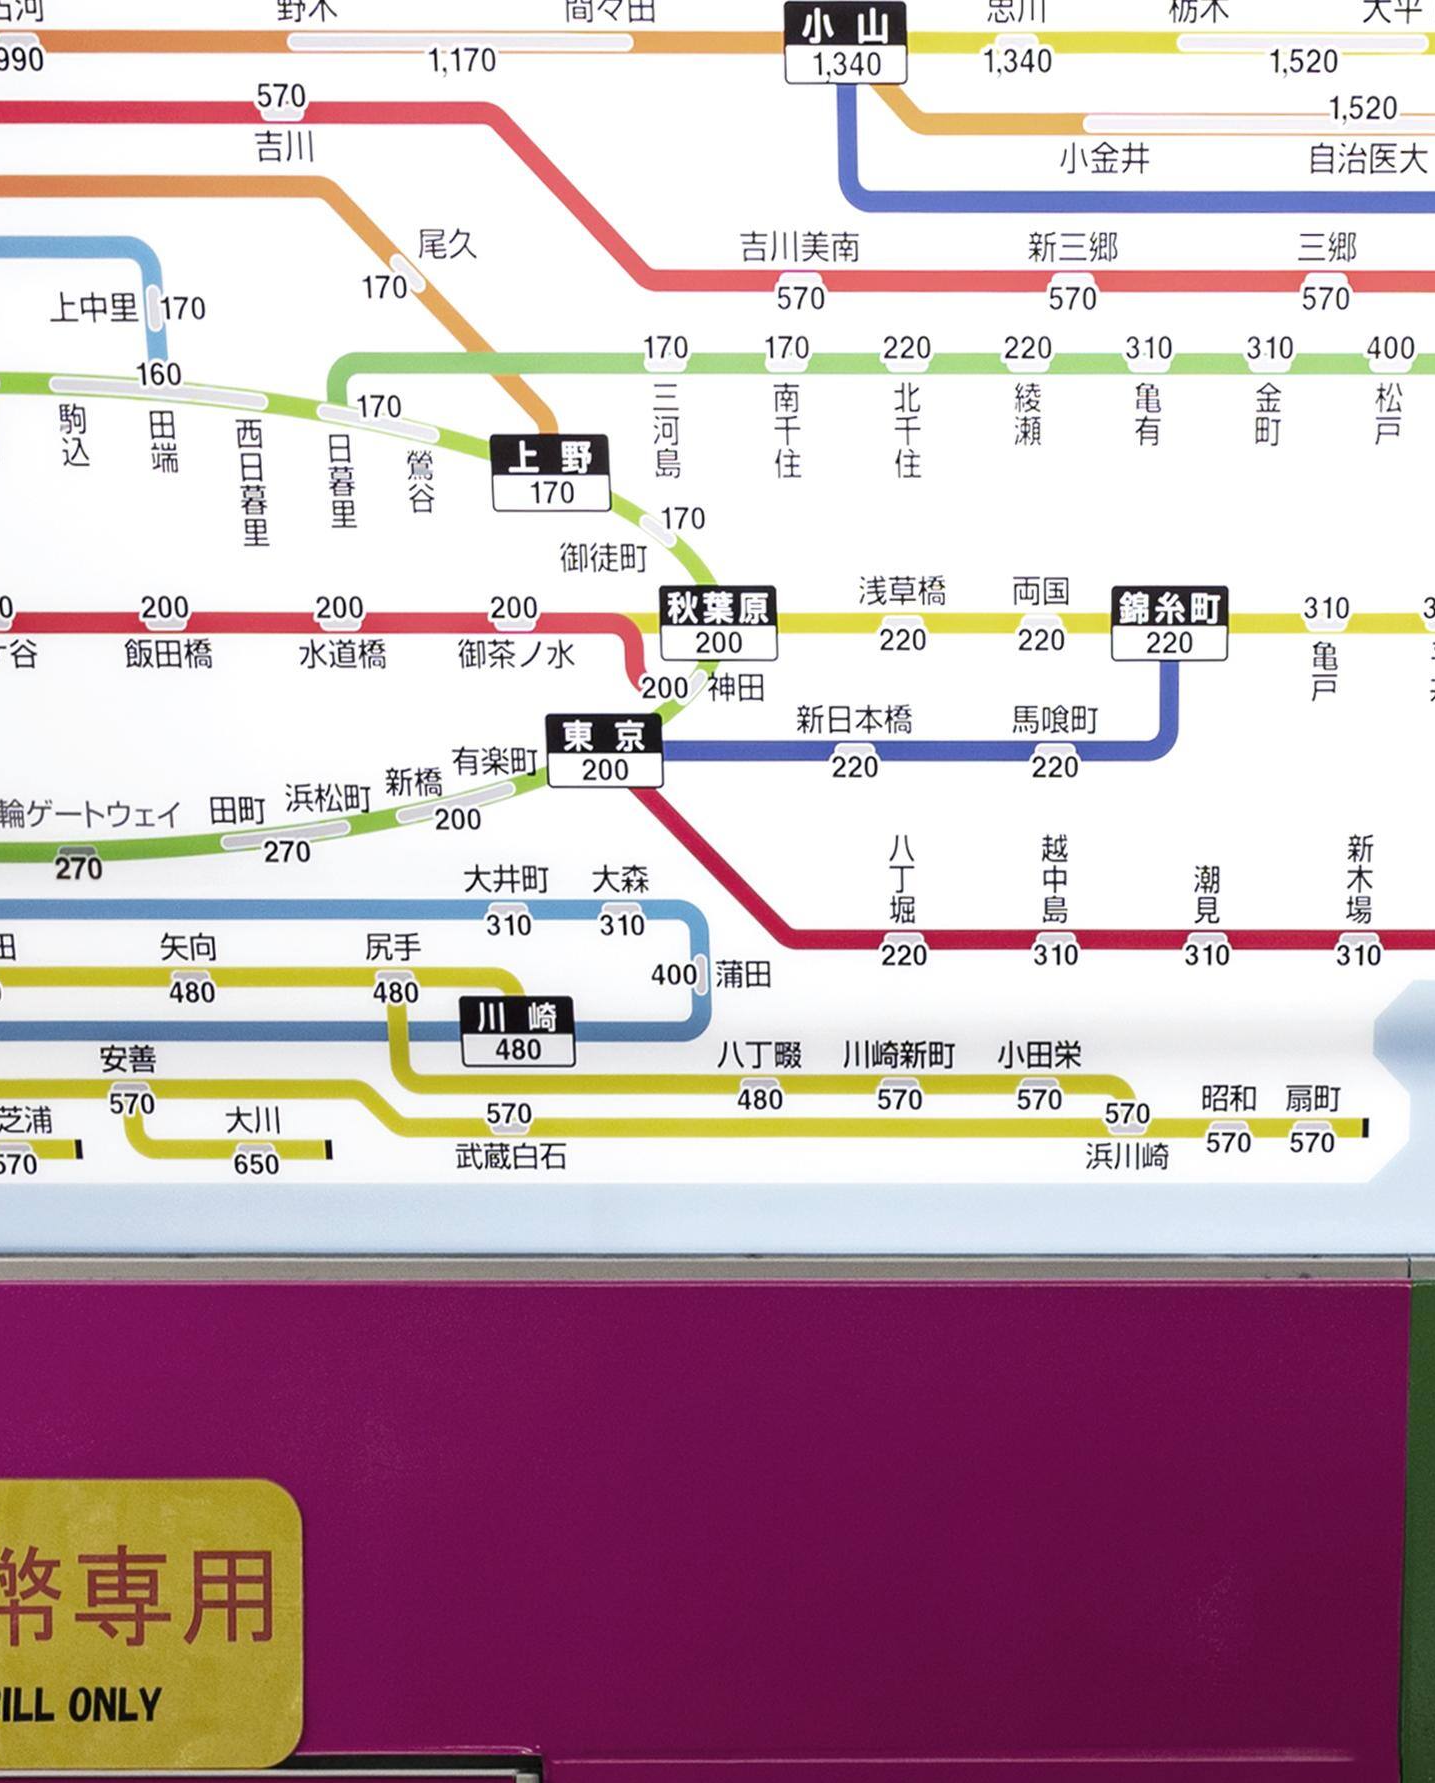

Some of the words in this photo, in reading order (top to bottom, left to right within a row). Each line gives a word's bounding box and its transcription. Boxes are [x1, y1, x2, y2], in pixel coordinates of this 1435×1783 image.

[429, 47, 496, 73] 1,170
[813, 51, 881, 77] 1,340
[1310, 142, 1428, 175] 自治医大
[418, 228, 477, 260] 尾久
[740, 230, 859, 263] 吉川美南
[1028, 231, 1118, 263] 新三郷
[560, 542, 648, 573] 御徒町
[667, 592, 769, 625] 秋葉原
[695, 631, 743, 654] 200
[796, 704, 912, 734] 新日本橋
[843, 1039, 956, 1070] 川崎新町
[69, 1687, 162, 1722] ONLY
